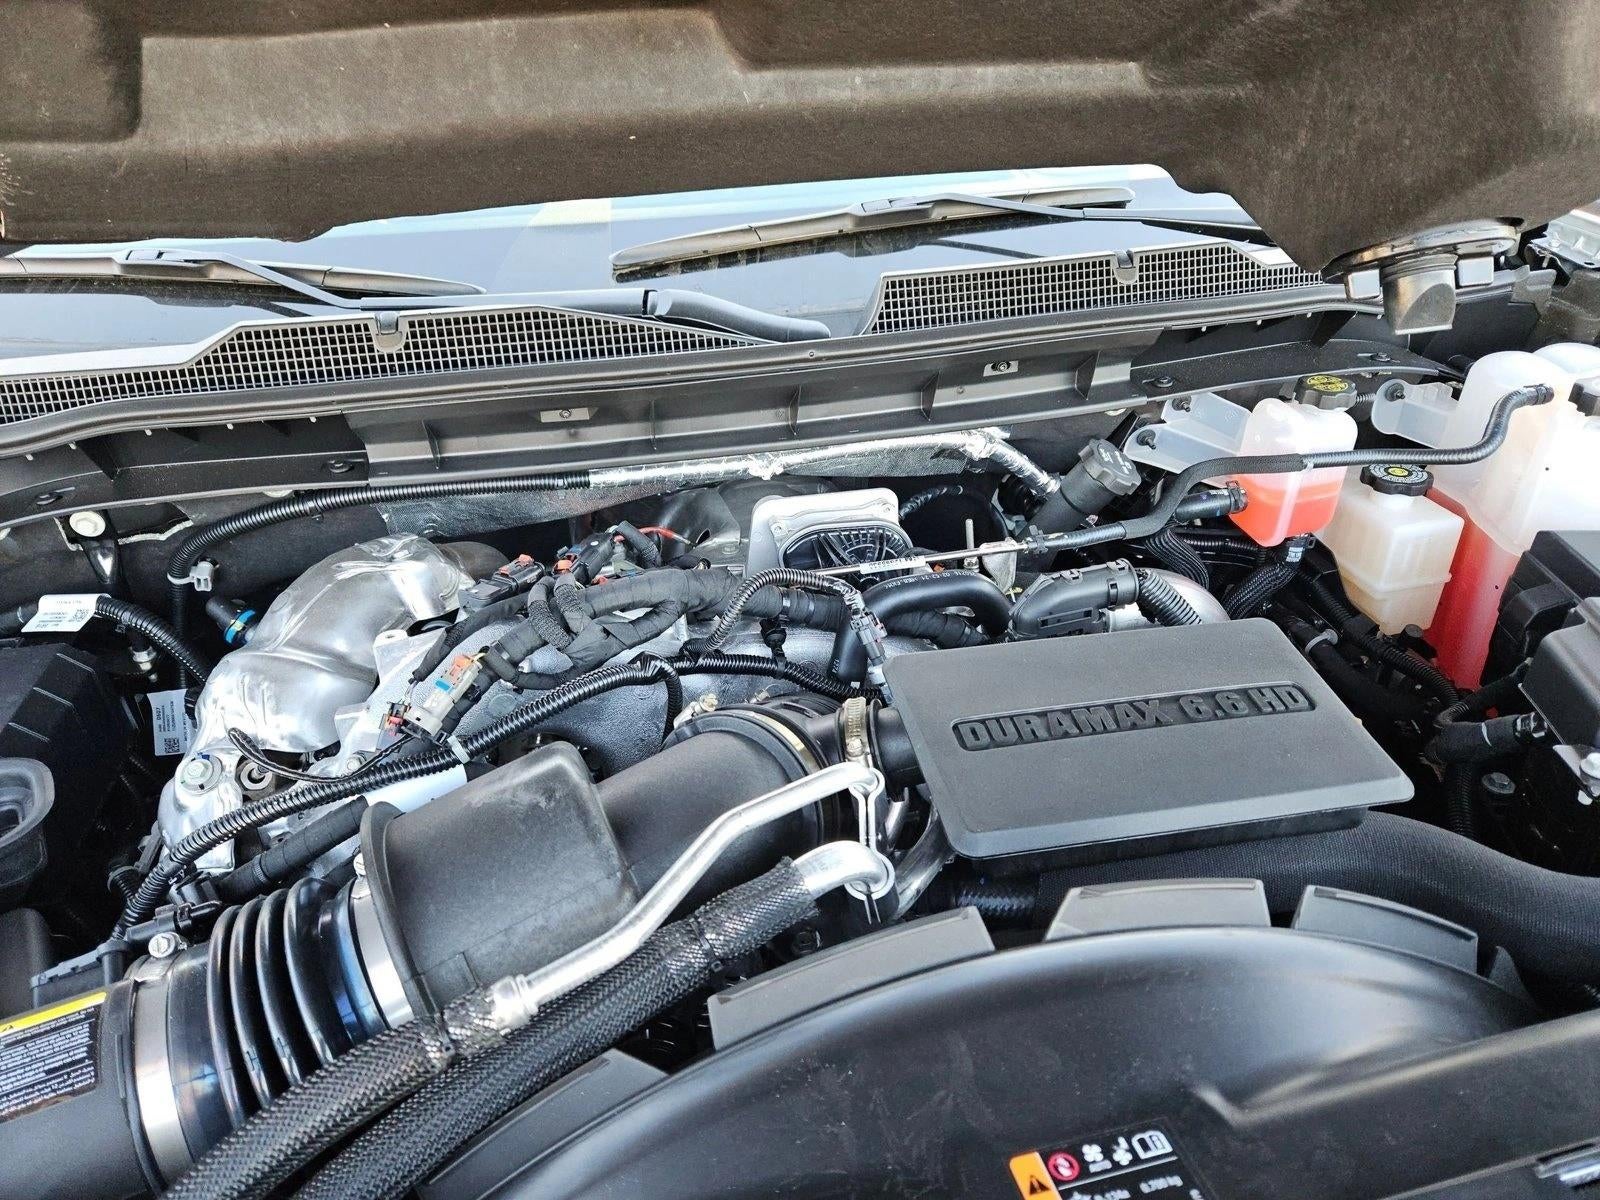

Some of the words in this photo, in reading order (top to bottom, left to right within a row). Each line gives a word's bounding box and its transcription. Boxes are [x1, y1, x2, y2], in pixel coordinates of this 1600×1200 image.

[957, 699, 1174, 748] DURAMAX
[1179, 691, 1249, 720] 6.6
[1247, 685, 1309, 713] HD
